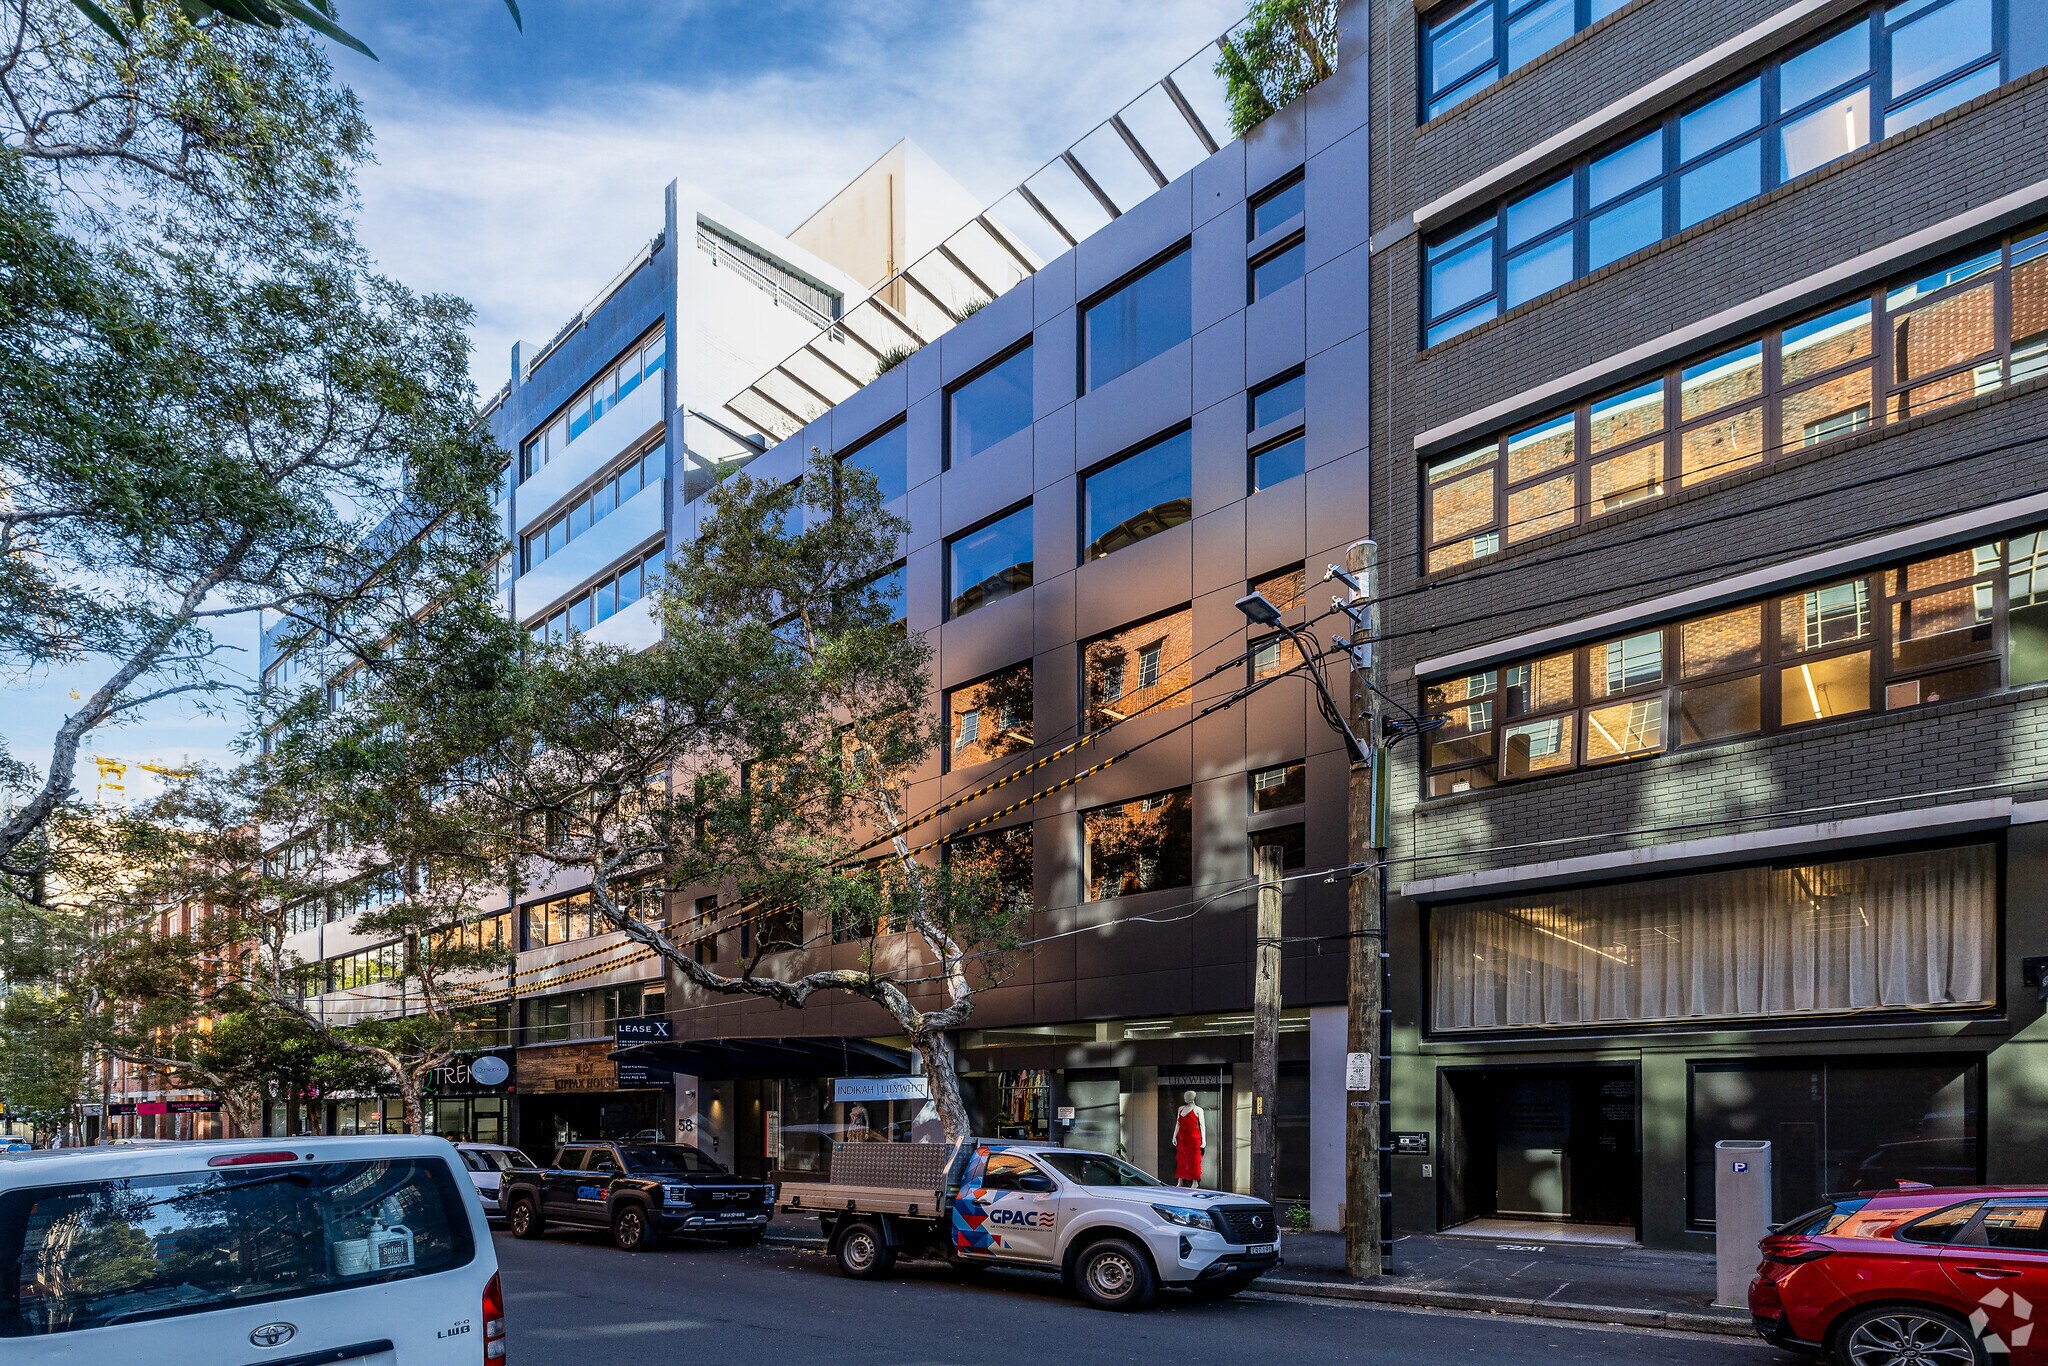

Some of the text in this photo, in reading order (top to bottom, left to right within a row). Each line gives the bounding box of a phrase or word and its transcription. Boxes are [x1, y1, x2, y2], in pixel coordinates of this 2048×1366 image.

[618, 1022, 669, 1036] LEASE X
[554, 1078, 586, 1091] KIPPAX
[837, 1085, 874, 1095] INDIKAH
[881, 1083, 925, 1094] LILYWHYT
[678, 1118, 693, 1132] 58
[1734, 1162, 1746, 1172] P
[577, 1185, 602, 1199] GPAC
[712, 1192, 750, 1200] BYD
[990, 1209, 1038, 1227] GPAC
[437, 1325, 471, 1339] LWB
